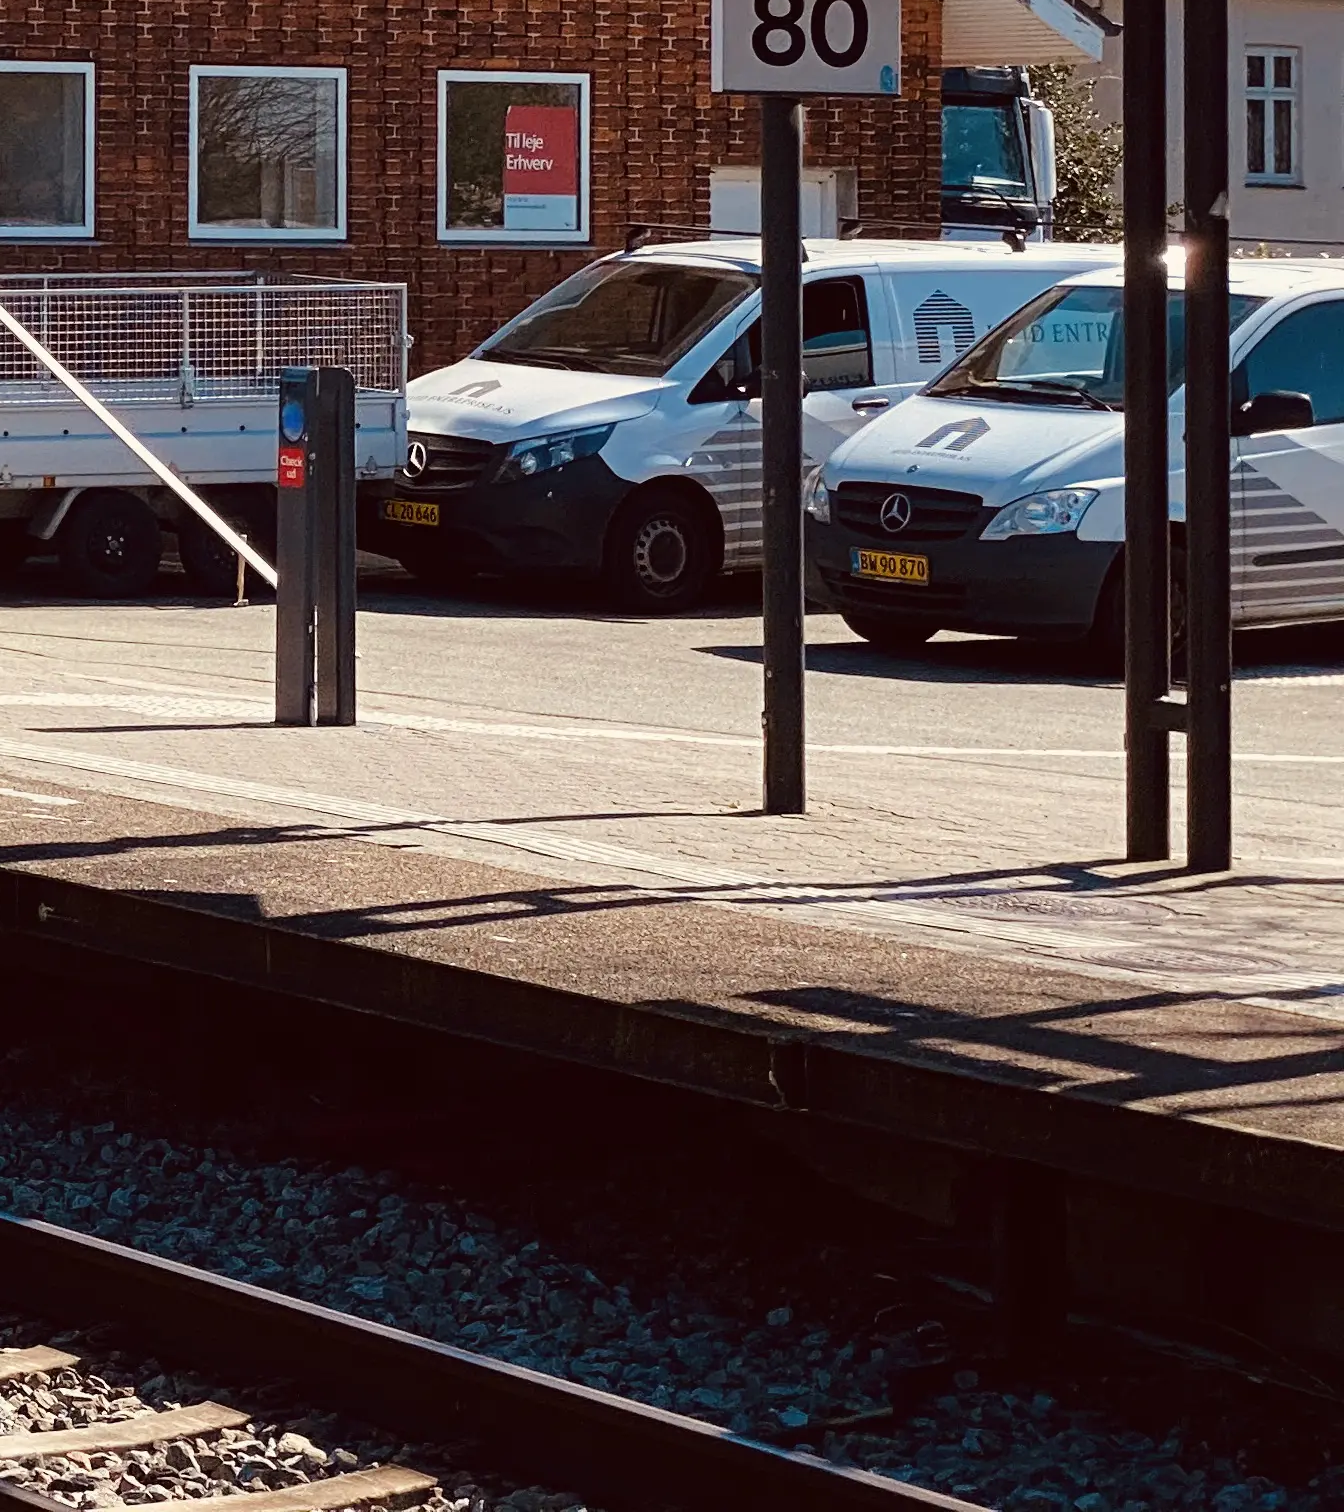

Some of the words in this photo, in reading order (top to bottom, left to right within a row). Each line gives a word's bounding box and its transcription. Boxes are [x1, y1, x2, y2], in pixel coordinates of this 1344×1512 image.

[505, 132, 520, 149] Til
[521, 132, 544, 153] leje
[505, 154, 553, 171] Erhverv
[279, 455, 303, 467] Check
[286, 468, 297, 479] ud
[400, 503, 414, 520] 20
[415, 504, 437, 522] 646
[860, 552, 878, 572] BW
[879, 555, 897, 574] 90
[899, 558, 925, 578] 870
